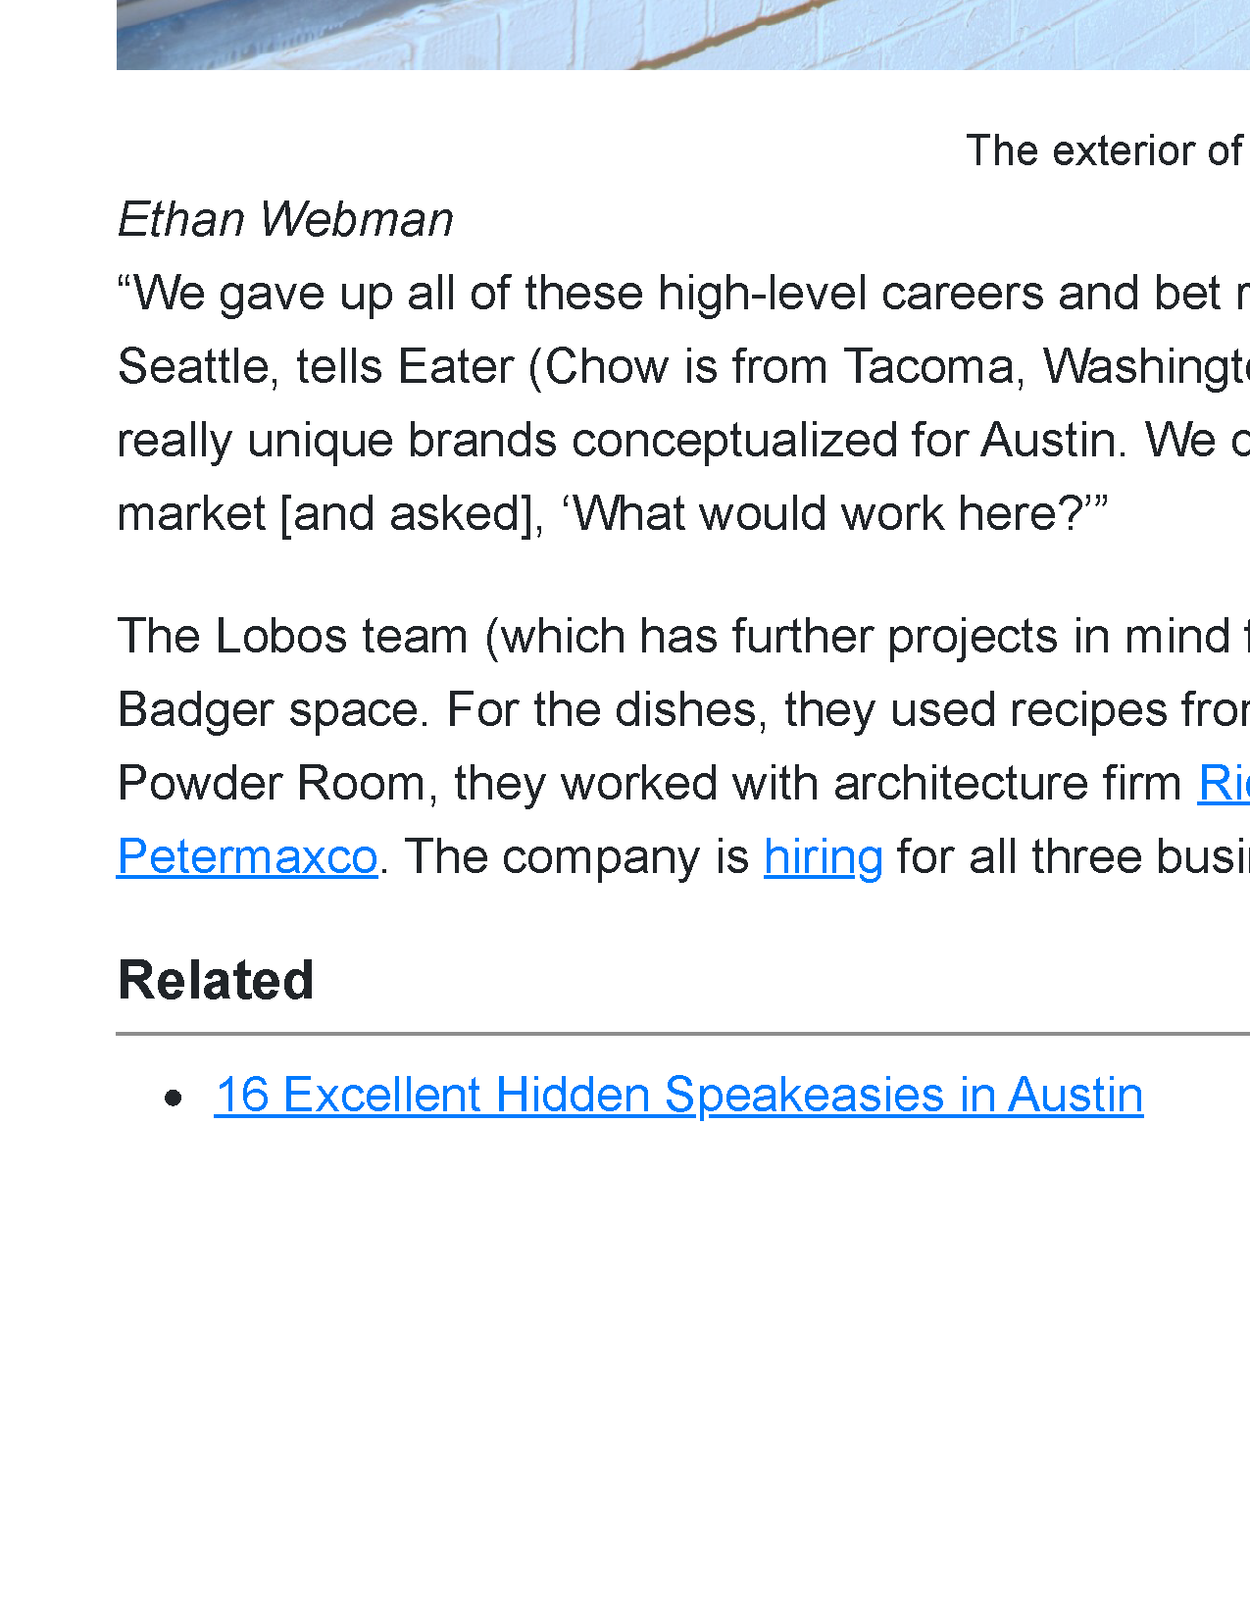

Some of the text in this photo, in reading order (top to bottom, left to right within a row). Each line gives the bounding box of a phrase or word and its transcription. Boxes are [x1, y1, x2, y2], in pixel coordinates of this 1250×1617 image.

[967, 134, 1037, 165] The
[1054, 134, 1196, 165] exterior
[1209, 134, 1244, 165] of
[118, 200, 453, 237] Ethan Webman
[119, 274, 204, 309] “We
[220, 283, 324, 319] gave
[342, 283, 392, 319] up
[409, 274, 453, 309] all
[471, 274, 512, 309] of
[525, 274, 642, 309] these
[661, 274, 865, 319] high-level
[883, 283, 1043, 309] careers
[1060, 274, 1137, 309] and
[1157, 274, 1221, 309] bet
[120, 346, 277, 391] Seattle,
[297, 347, 381, 383] tells
[401, 347, 515, 383] Eater
[530, 346, 669, 393] (Chow
[687, 347, 717, 383] is
[732, 347, 826, 383] from
[844, 347, 1023, 391] Tacoma,
[119, 421, 232, 466] really
[250, 421, 392, 466] unique
[411, 421, 556, 456] brands
[573, 421, 896, 466] conceptualized
[912, 421, 970, 456] for
[980, 421, 1125, 456] Austin.
[1145, 421, 1215, 456] We
[119, 494, 1107, 540] market [and asked], ‘What would work here?’”
[118, 617, 199, 653] The
[218, 617, 346, 653] Lobos
[363, 618, 466, 653] team
[487, 617, 624, 662] (which
[642, 617, 717, 653] has
[732, 617, 875, 653] further
[890, 617, 1057, 662] projects
[1076, 617, 1108, 653] in
[1127, 617, 1229, 653] mind
[120, 691, 275, 736] Badger
[290, 699, 427, 736] space.
[450, 691, 520, 726] For
[534, 691, 600, 726] the
[617, 691, 765, 734] dishes,
[785, 691, 876, 736] they
[893, 691, 994, 726] used
[1013, 691, 1167, 736] recipes
[120, 764, 283, 800] Powder
[300, 764, 435, 807] Room,
[455, 764, 546, 809] they
[561, 764, 716, 800] worked
[732, 764, 817, 800] with
[835, 764, 1087, 800] architecture
[1103, 764, 1180, 800] firm
[119, 838, 386, 874] Petermaxco.
[405, 838, 487, 873] The
[504, 846, 700, 883] company
[718, 838, 748, 873] is
[764, 838, 882, 883] hiring
[897, 838, 955, 873] for
[970, 838, 1015, 873] all
[1032, 838, 1141, 873] three
[120, 959, 312, 1000] Related
[219, 1075, 1141, 1121] 16 Excellent Hidden Speakeasies in Austin
